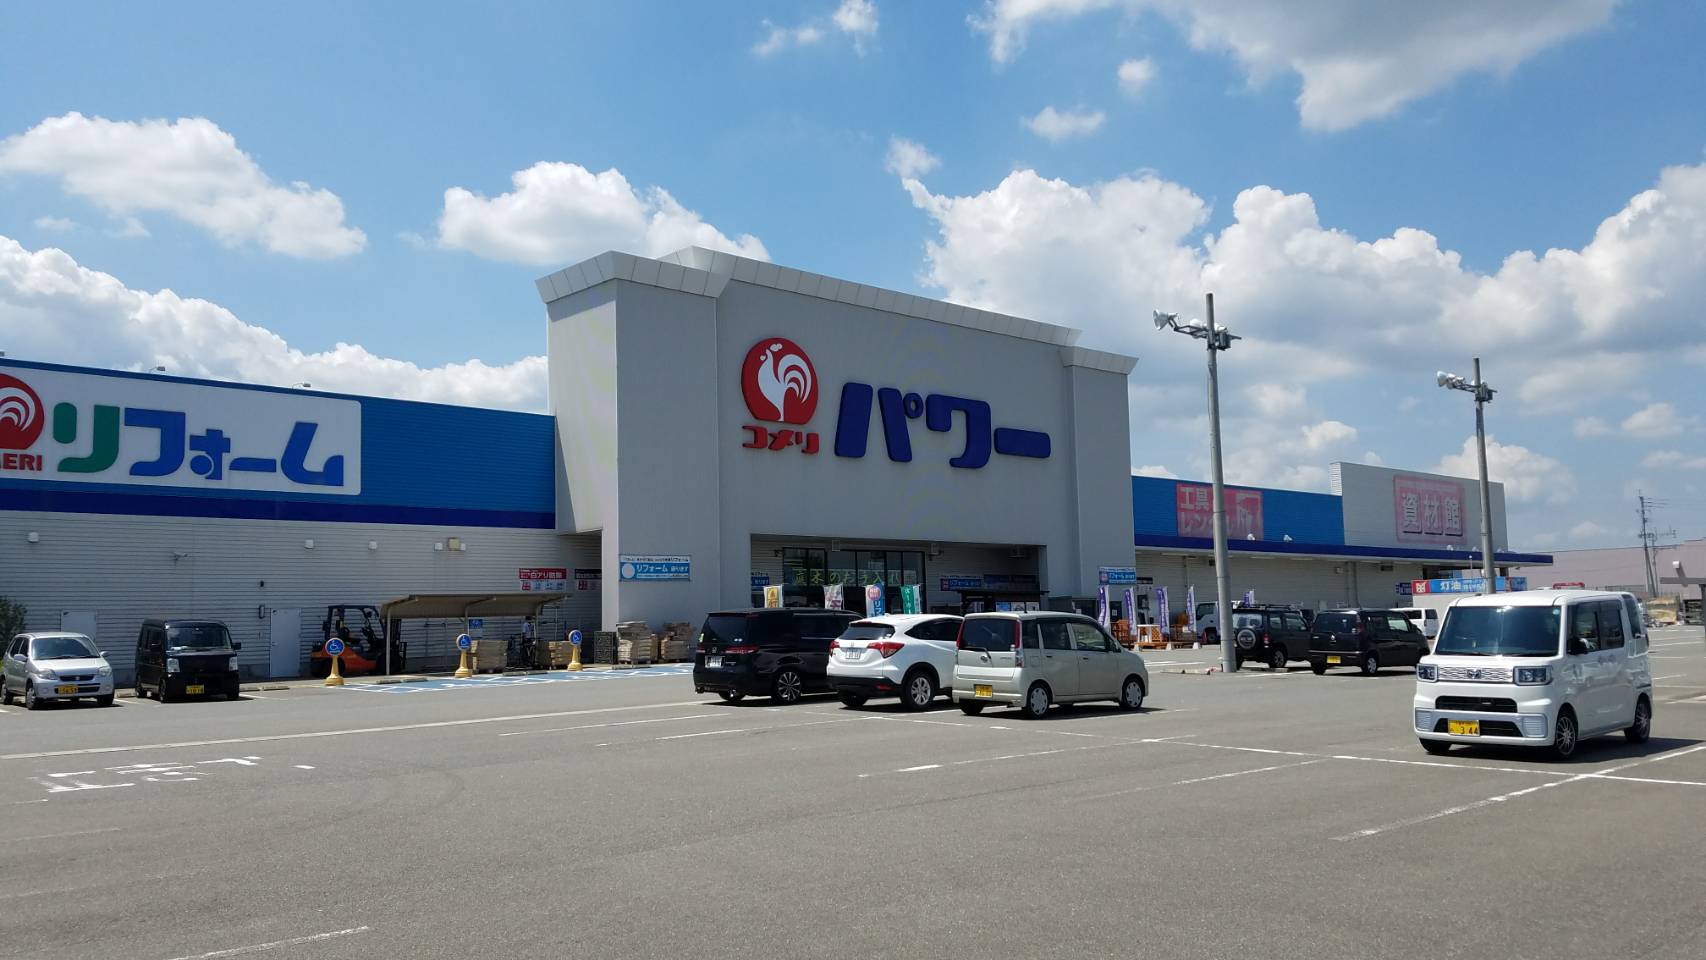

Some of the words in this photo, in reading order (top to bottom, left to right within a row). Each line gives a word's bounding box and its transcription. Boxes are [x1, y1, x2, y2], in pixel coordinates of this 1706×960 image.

[834, 382, 1051, 469] パワー
[53, 401, 344, 487] リフォーム
[742, 425, 819, 455] コメリ
[0, 453, 43, 472] ERI
[1180, 487, 1210, 511] 工具
[1402, 493, 1460, 531] 資材館
[1180, 511, 1234, 536] レンル
[636, 564, 668, 573] リフォーム
